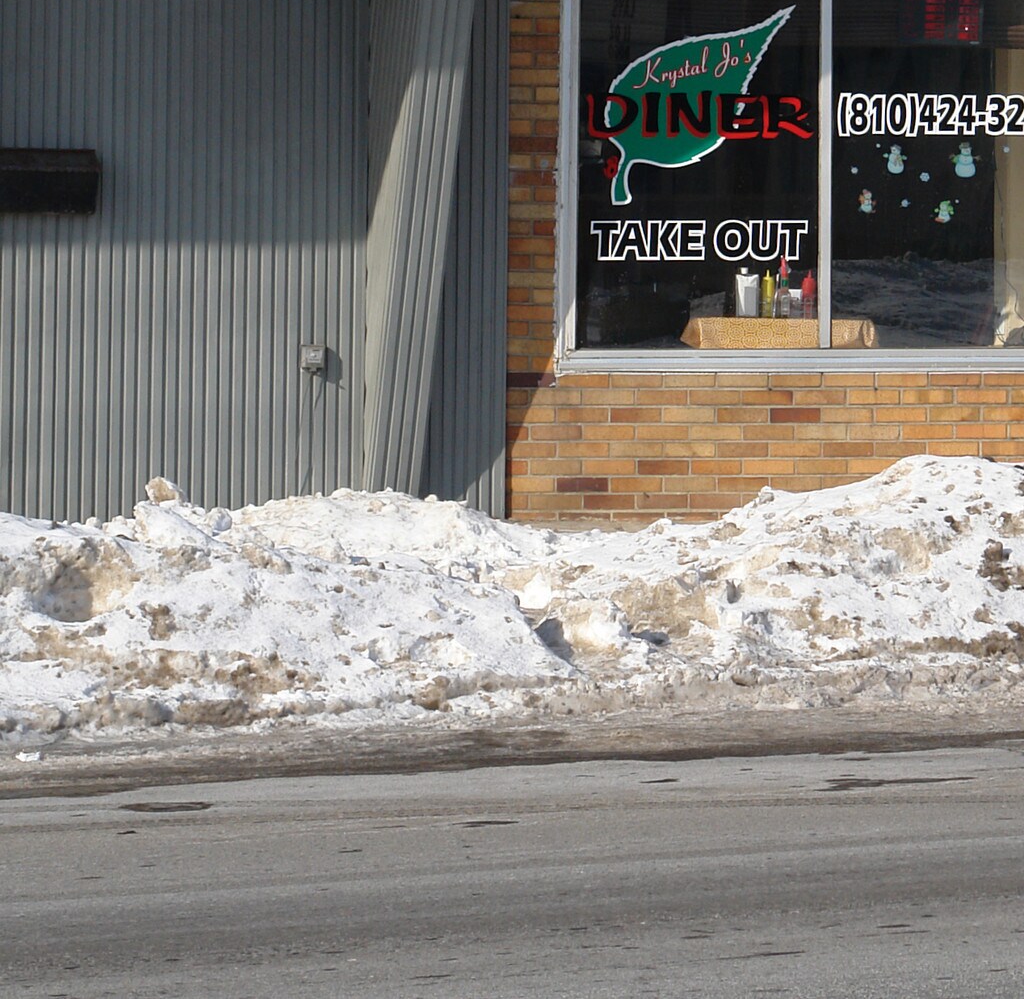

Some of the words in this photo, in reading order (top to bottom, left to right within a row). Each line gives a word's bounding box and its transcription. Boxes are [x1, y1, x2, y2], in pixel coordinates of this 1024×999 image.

[632, 45, 709, 89] Krystal
[714, 39, 753, 78] Jo's
[586, 90, 815, 140] DINER
[591, 219, 705, 261] TAKE
[713, 219, 808, 261] OUT
